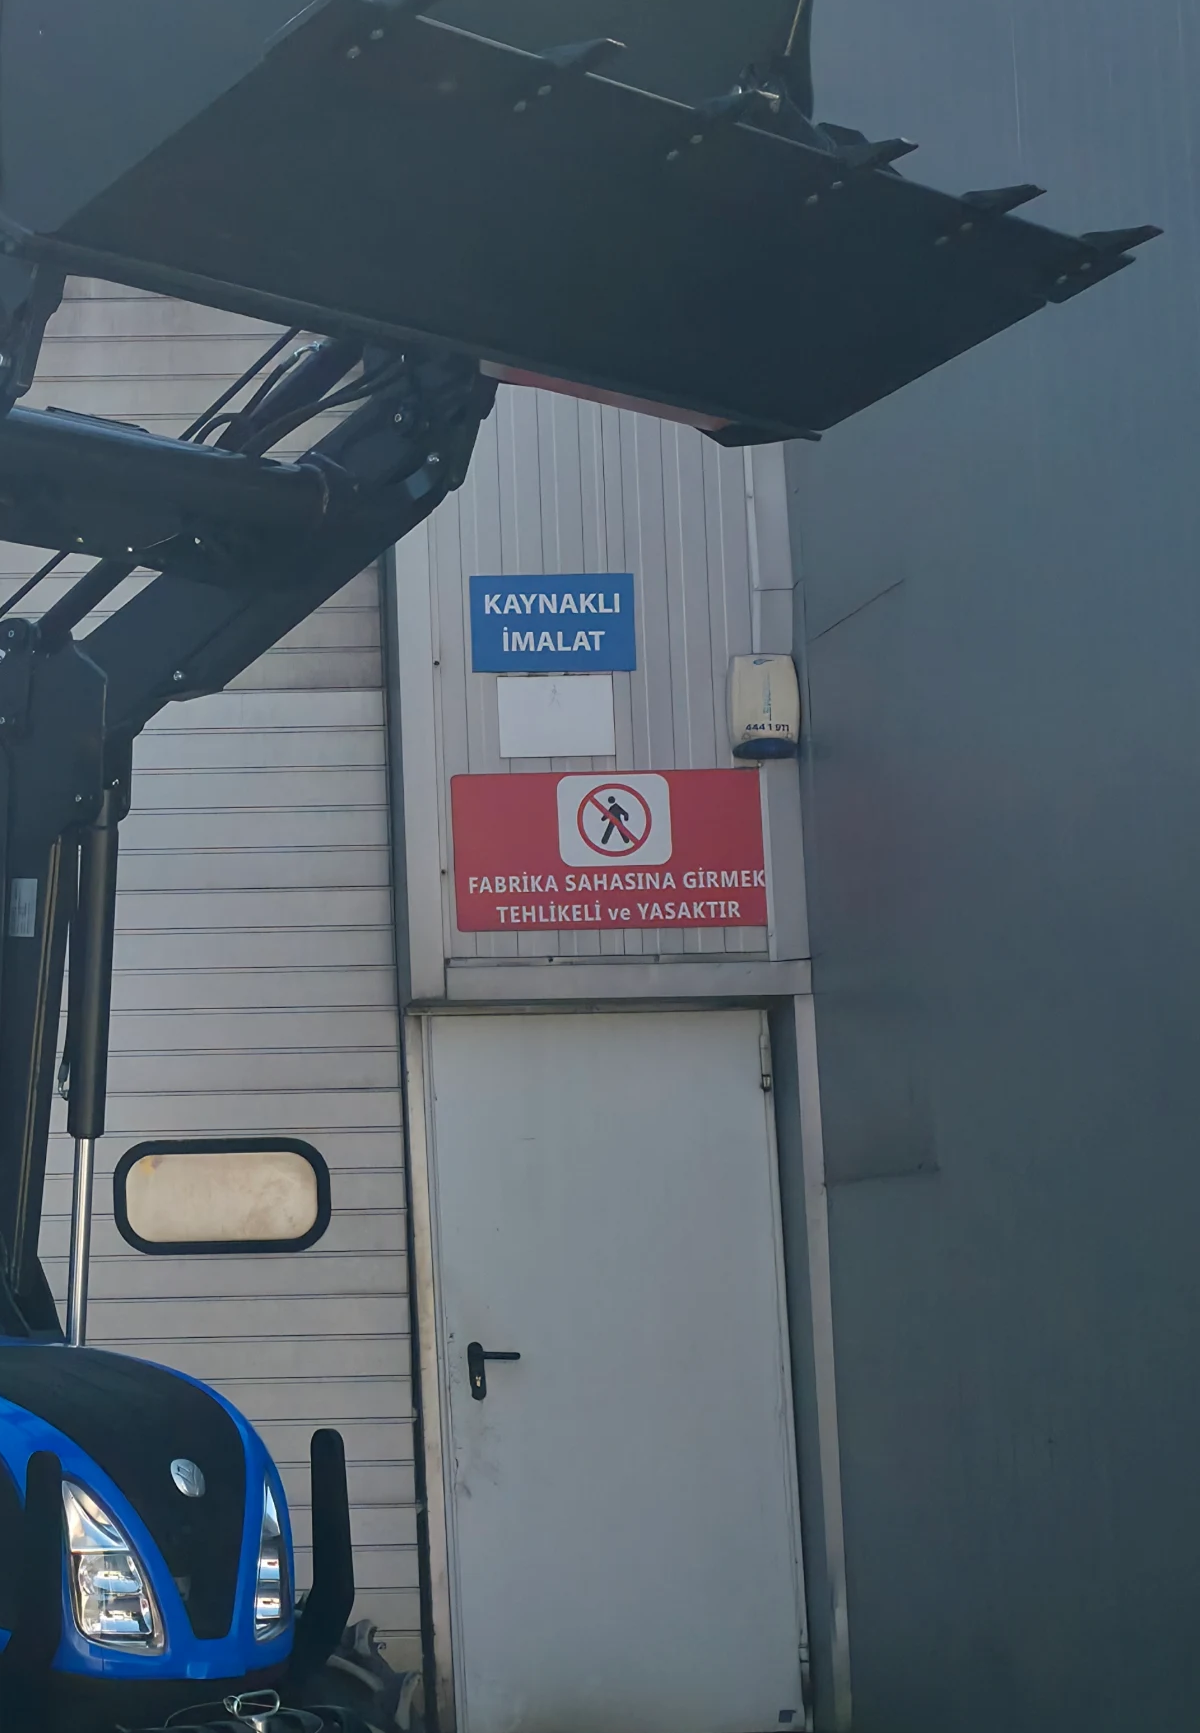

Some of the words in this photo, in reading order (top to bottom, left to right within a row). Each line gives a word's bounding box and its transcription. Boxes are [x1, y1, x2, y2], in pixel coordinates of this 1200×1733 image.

[484, 592, 620, 615] KAYNAKLI
[502, 626, 605, 652] İMALAT
[745, 723, 765, 731] 444
[468, 871, 559, 894] FABRİKA
[565, 872, 676, 892] SAHASINA
[683, 867, 766, 889] GİRMEK
[496, 900, 602, 924] TEHLİKELİ
[608, 908, 631, 921] ve
[637, 900, 741, 920] YASAKTIR
